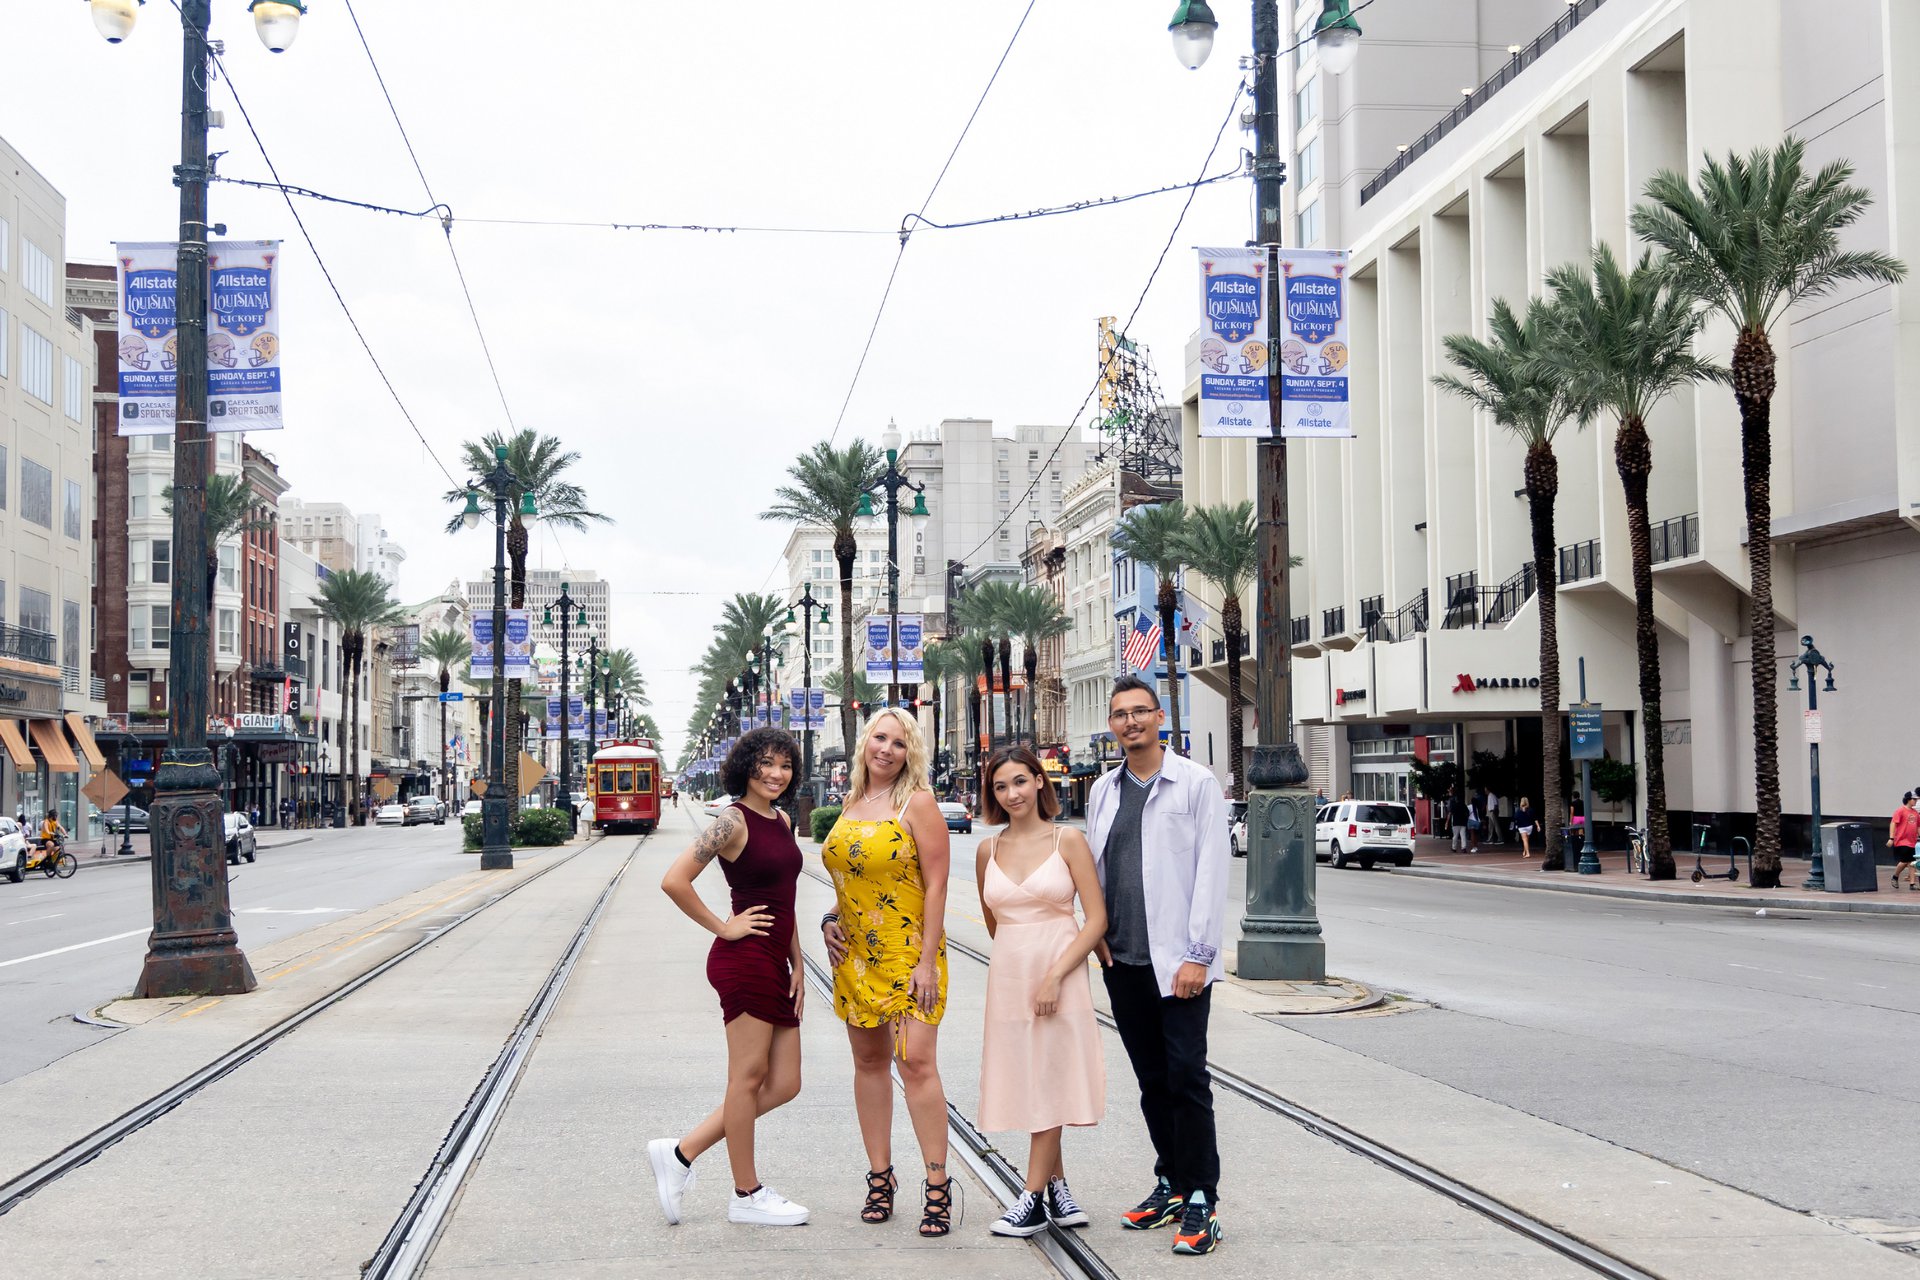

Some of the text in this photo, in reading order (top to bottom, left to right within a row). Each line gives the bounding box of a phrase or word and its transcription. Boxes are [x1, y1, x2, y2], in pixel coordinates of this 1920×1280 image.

[215, 274, 267, 287] Allstate
[1210, 281, 1256, 294] Allstate
[1289, 282, 1337, 295] Allstate
[128, 294, 176, 315] LOUISIAN
[214, 292, 270, 313] LOUISIANA
[1208, 298, 1259, 320] LOUISIANA
[1288, 299, 1340, 321] LOUISIANA
[221, 315, 264, 324] KICKOFF
[1214, 321, 1253, 331] KICKOFF
[1293, 322, 1333, 332] KICKOFF
[123, 374, 176, 383] SUNDAY, SEP
[210, 372, 245, 380] SUNDAY,
[269, 370, 275, 378] 4
[1205, 377, 1264, 387] SUNDAY, SEPT. 4
[1286, 378, 1344, 388] SUNDAY, SEPT. 4
[228, 405, 279, 416] SPORTSBOOK
[1217, 416, 1252, 426] Allstate
[1297, 417, 1332, 428] Allstate
